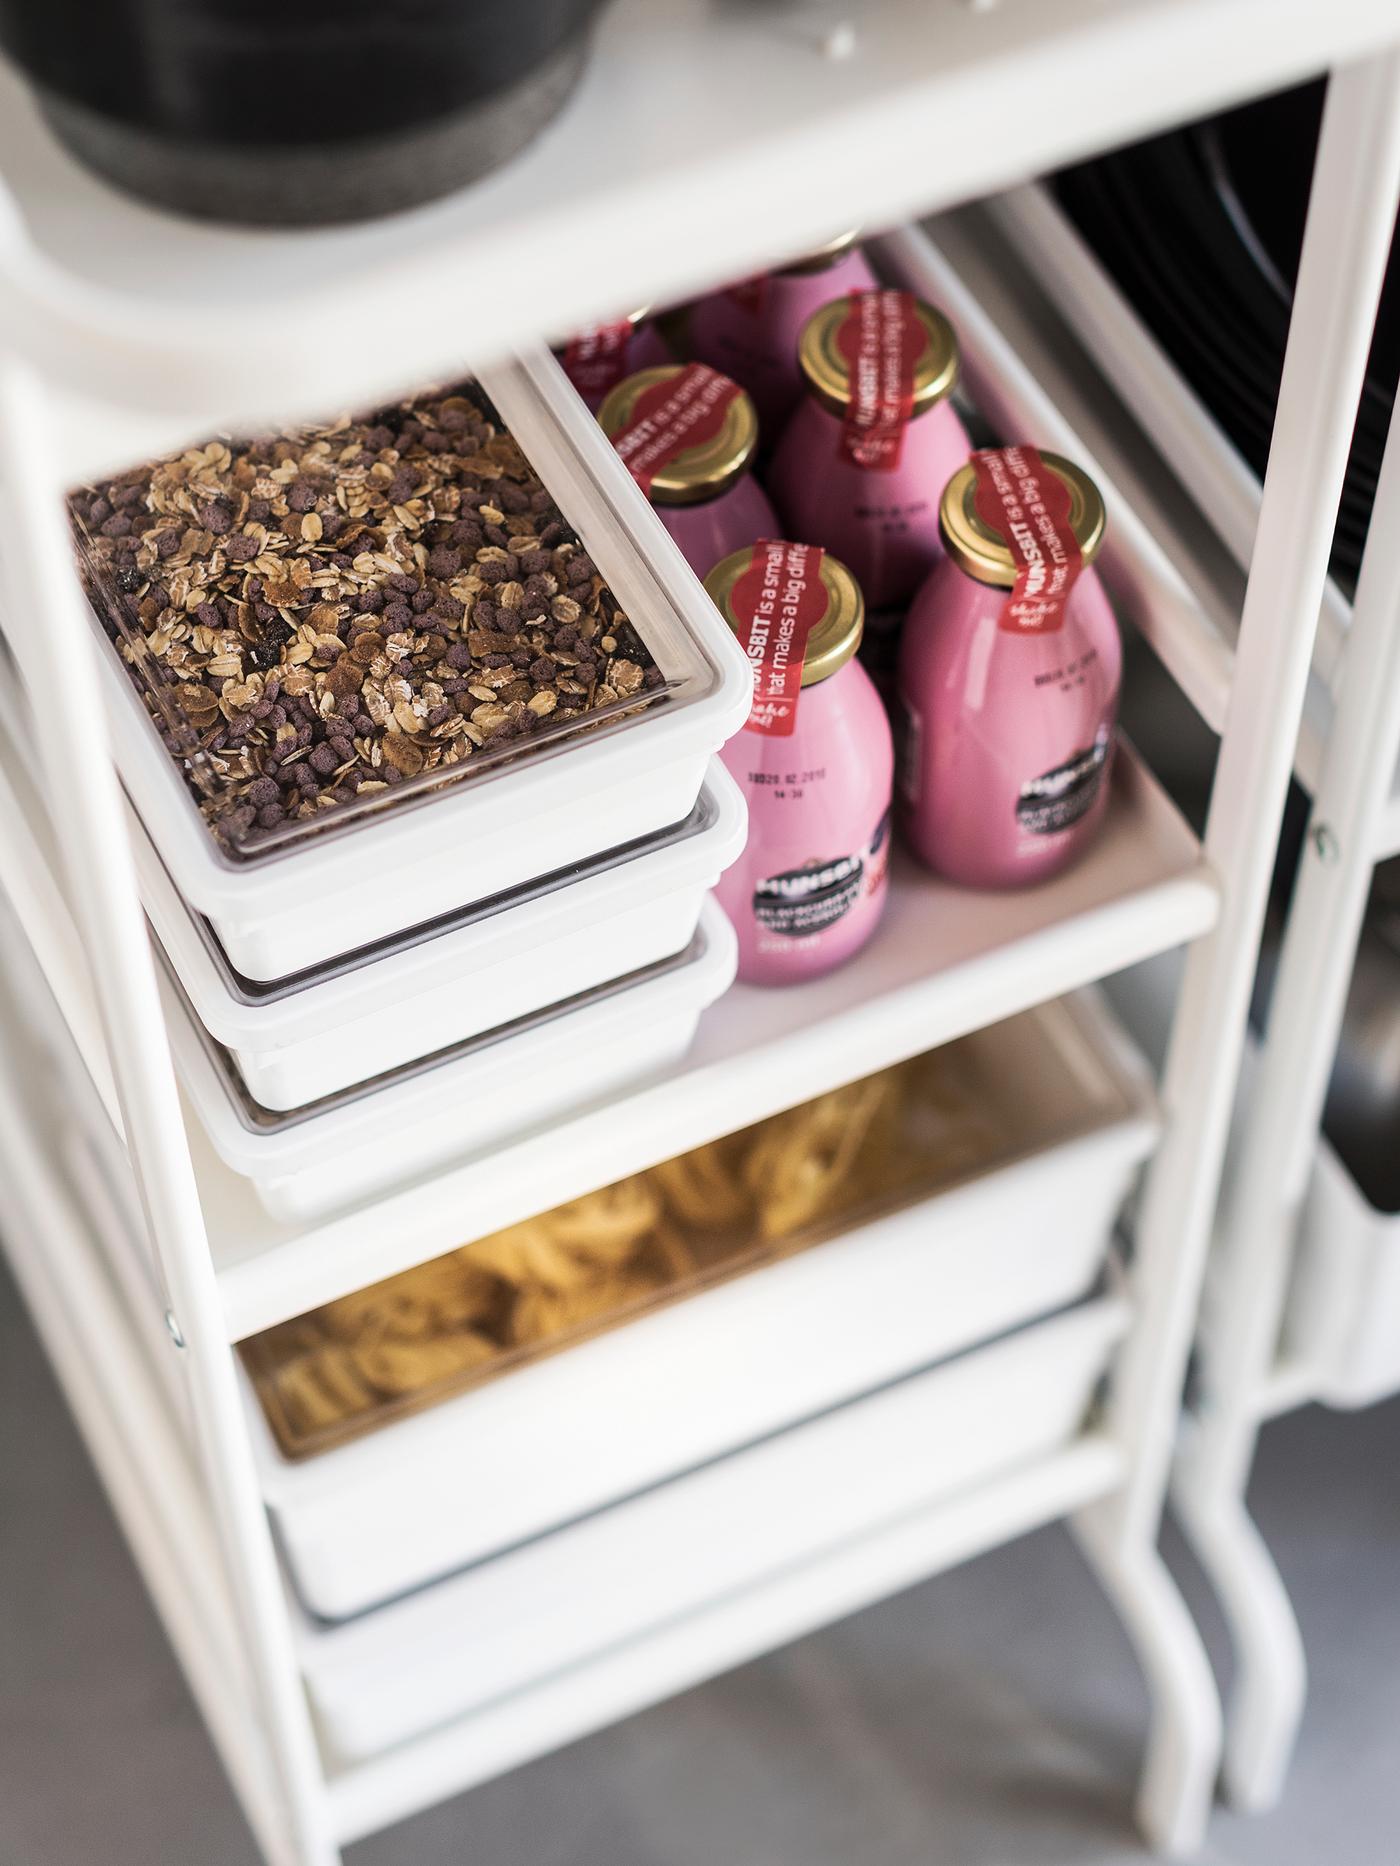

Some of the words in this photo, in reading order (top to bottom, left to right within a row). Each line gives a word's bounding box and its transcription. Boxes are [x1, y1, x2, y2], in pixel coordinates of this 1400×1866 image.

[1035, 514, 1068, 564] makes
[764, 543, 785, 588] small
[762, 589, 777, 601] a
[781, 579, 806, 604] big
[755, 601, 775, 615] is
[782, 606, 797, 619] a
[747, 615, 771, 697] UNSBIT
[773, 617, 795, 670] makes
[767, 672, 786, 696] that
